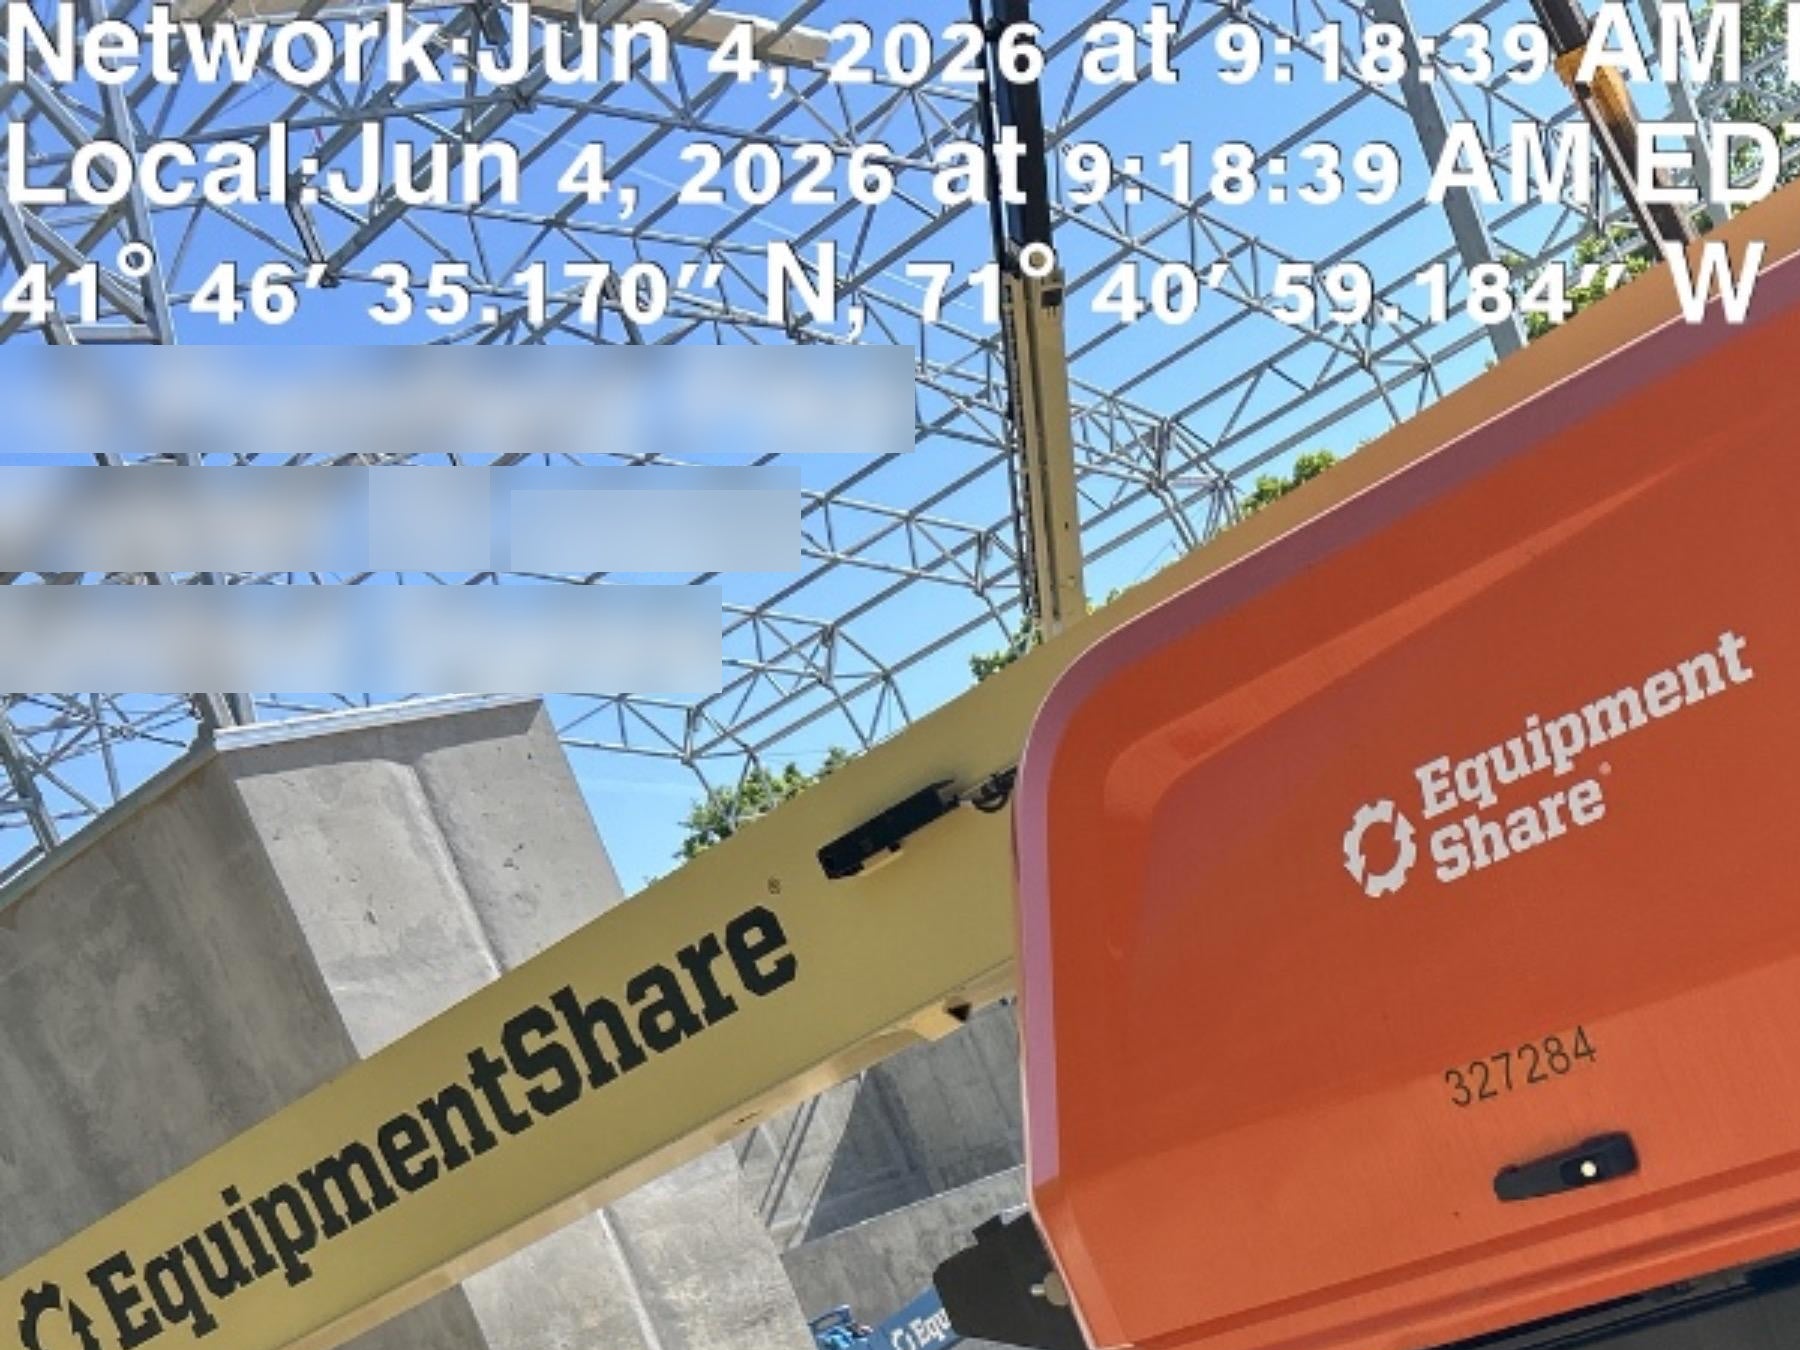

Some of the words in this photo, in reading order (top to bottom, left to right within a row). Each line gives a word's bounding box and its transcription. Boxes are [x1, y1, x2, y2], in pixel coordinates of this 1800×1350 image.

[1413, 629, 1754, 820] Equipment
[1429, 777, 1606, 883] Share
[1444, 1024, 1597, 1108] 327284
